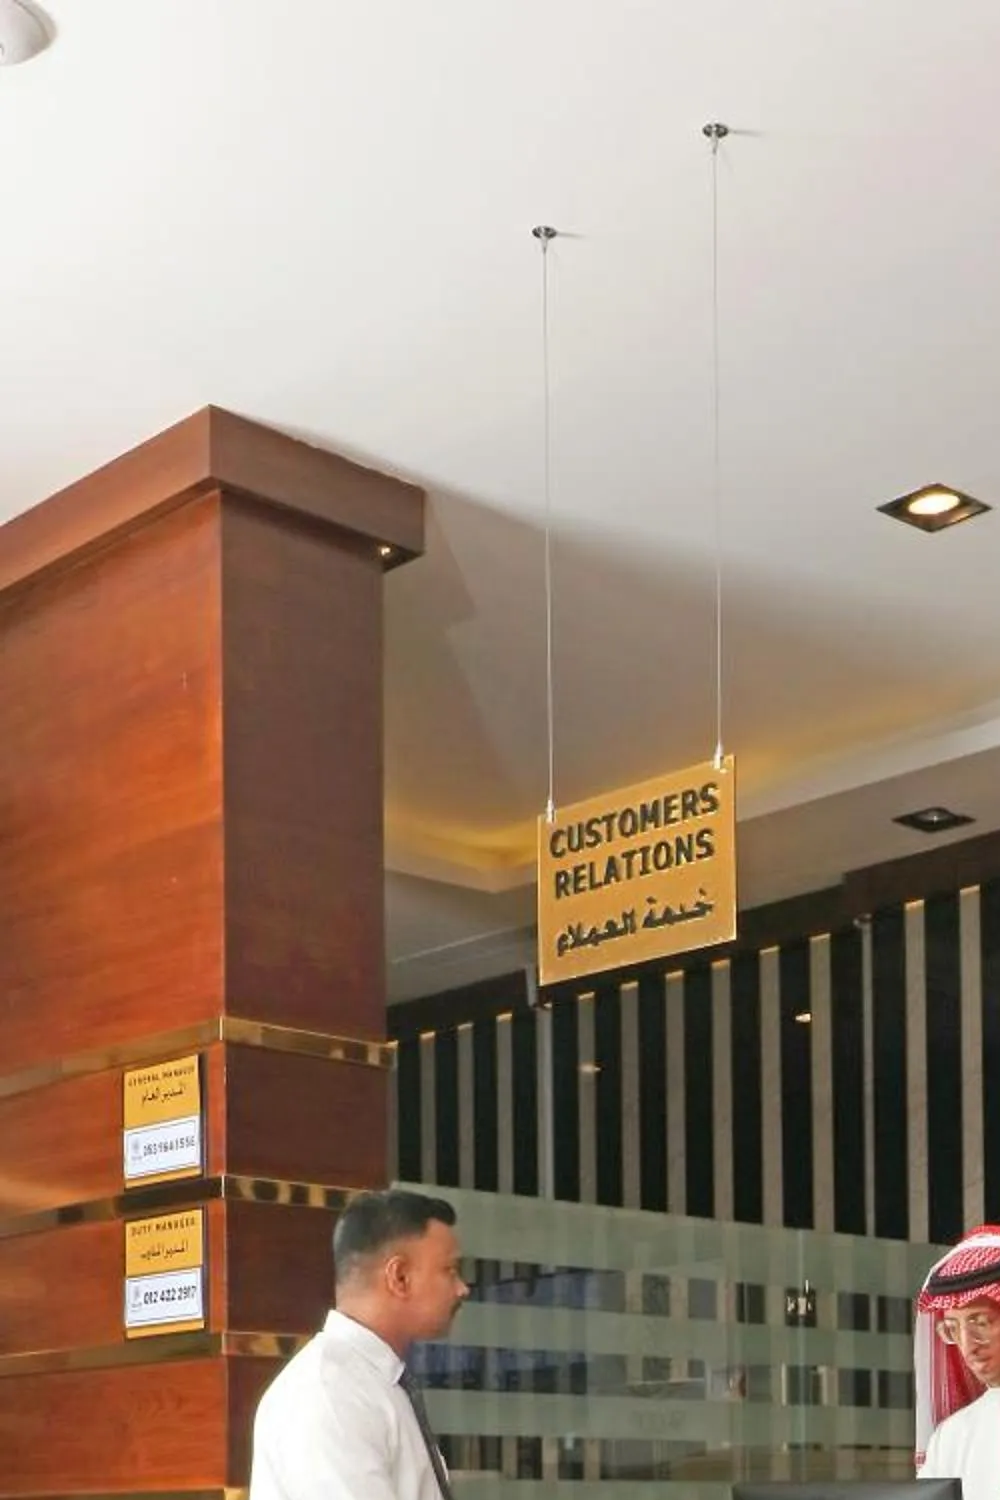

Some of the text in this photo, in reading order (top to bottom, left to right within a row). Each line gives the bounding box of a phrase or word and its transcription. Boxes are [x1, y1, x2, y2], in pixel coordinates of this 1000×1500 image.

[549, 781, 720, 859] CUSTOMERS
[554, 827, 716, 900] RELATIONS
[642, 887, 716, 929] خدمة
[130, 1215, 196, 1237] DUTY MANAGER
